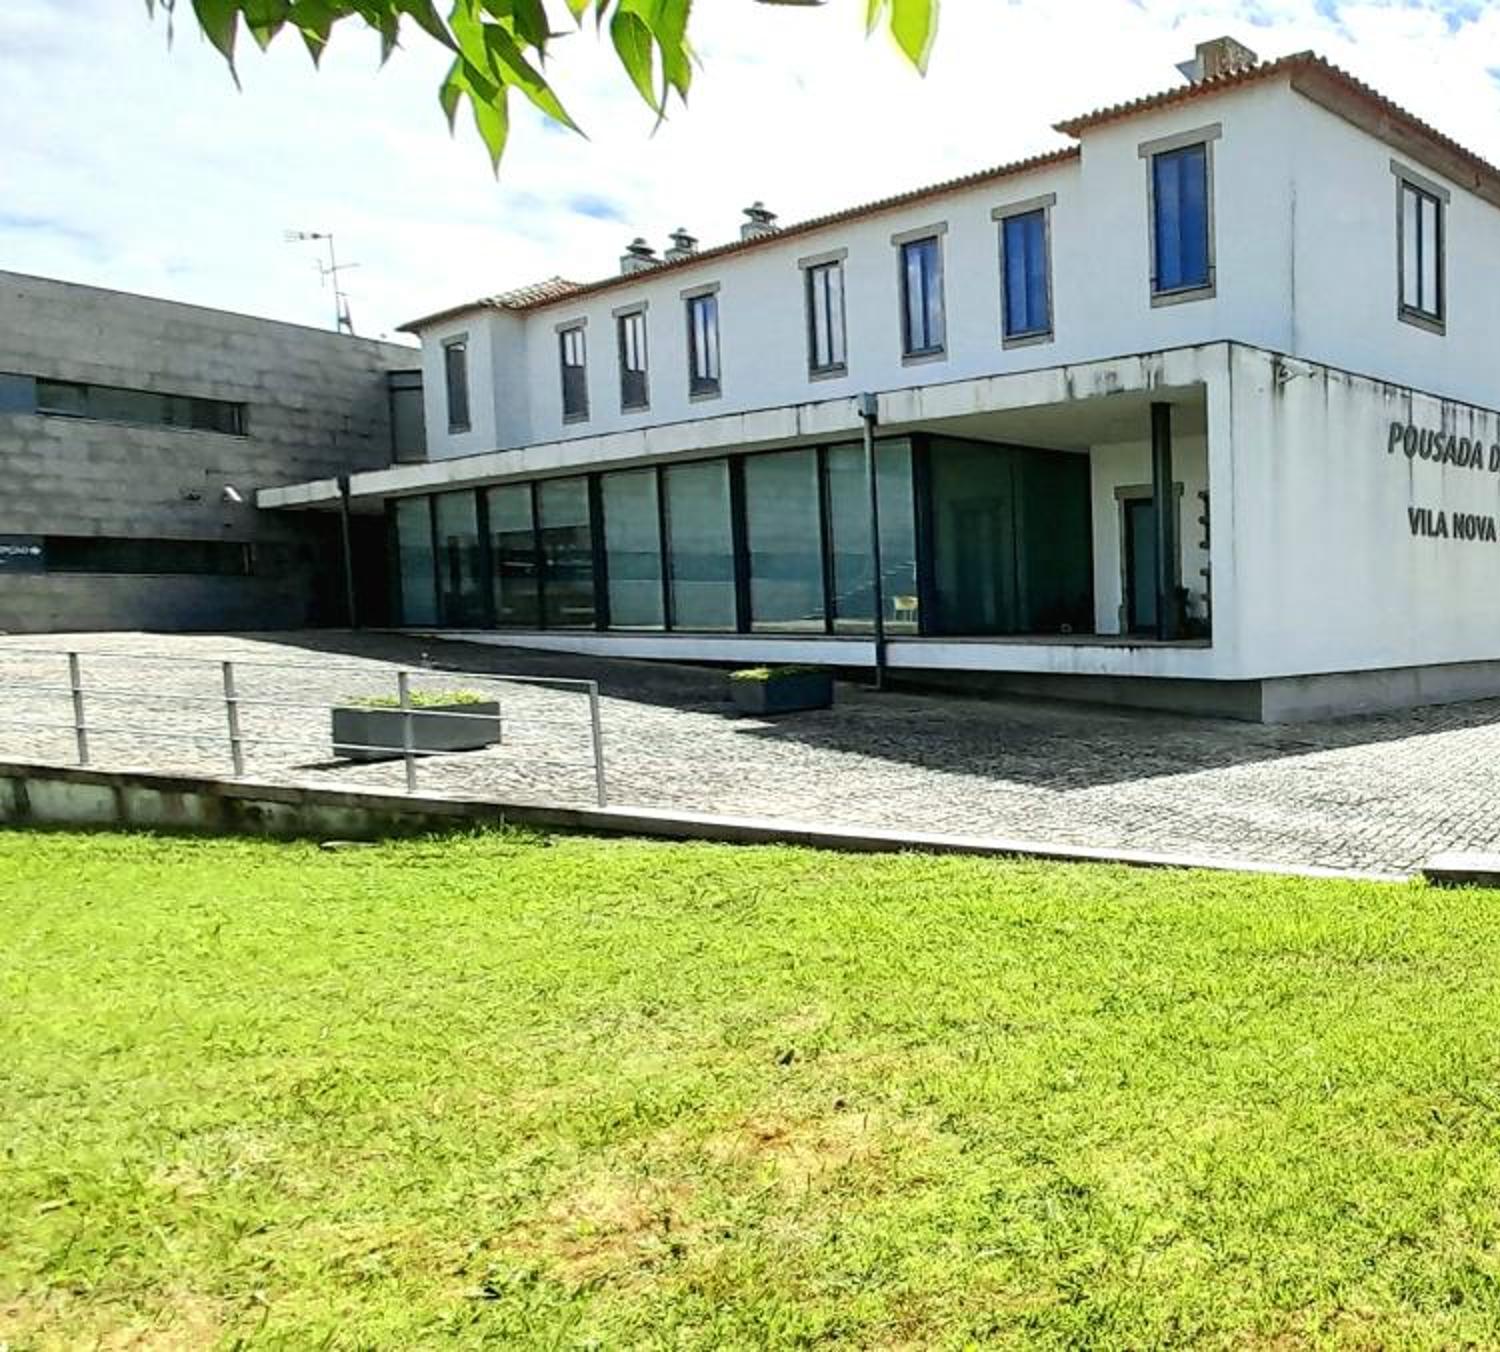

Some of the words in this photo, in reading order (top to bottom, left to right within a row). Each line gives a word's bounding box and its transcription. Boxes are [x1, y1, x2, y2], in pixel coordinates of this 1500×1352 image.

[1388, 421, 1484, 471] POUSADA
[1408, 507, 1449, 539] VILA
[1452, 512, 1497, 543] NOVA
